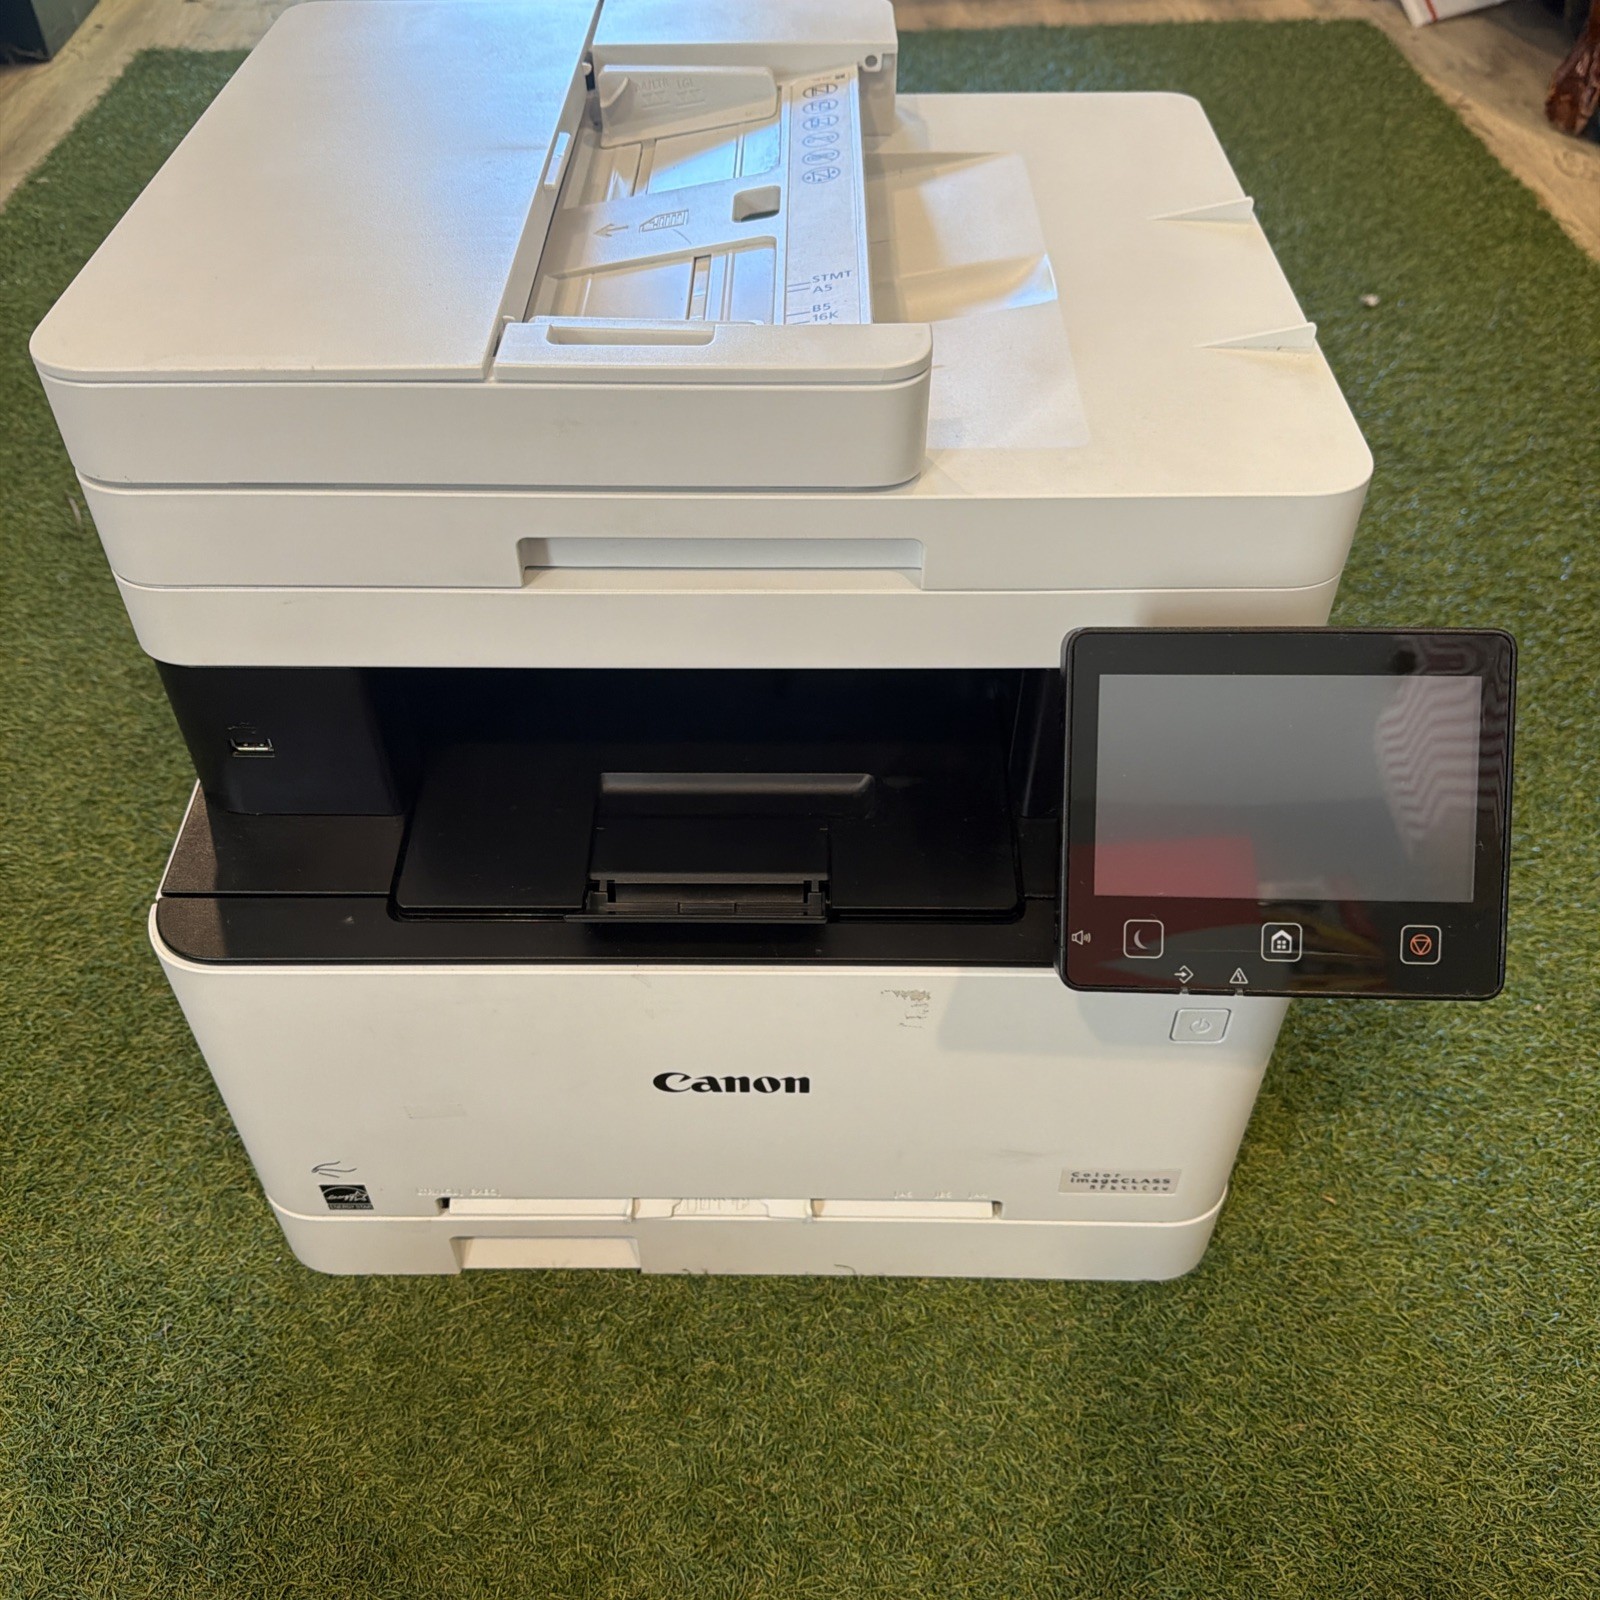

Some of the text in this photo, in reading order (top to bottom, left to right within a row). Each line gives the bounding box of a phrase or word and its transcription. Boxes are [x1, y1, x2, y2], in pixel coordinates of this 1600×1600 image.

[812, 270, 852, 283] STMT
[813, 284, 833, 294] A5
[812, 303, 831, 312] B5
[812, 311, 839, 322] 16K
[652, 1072, 810, 1093] Canon
